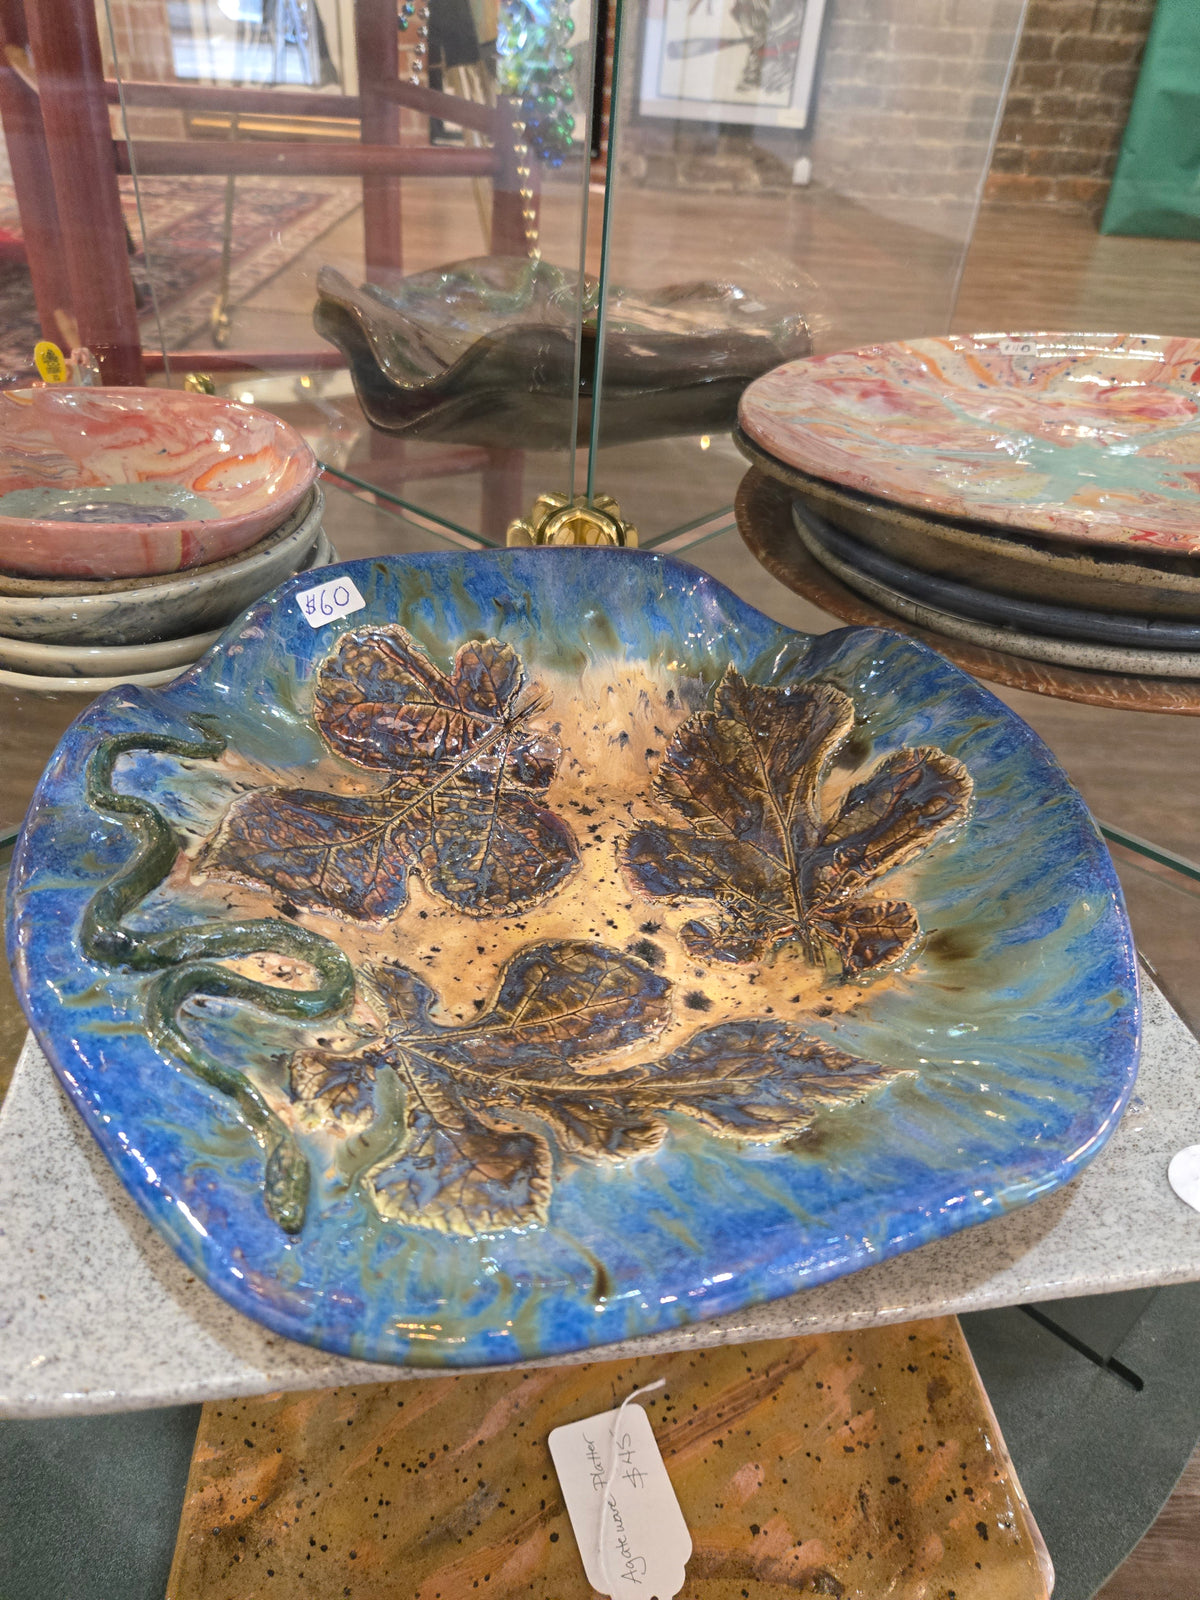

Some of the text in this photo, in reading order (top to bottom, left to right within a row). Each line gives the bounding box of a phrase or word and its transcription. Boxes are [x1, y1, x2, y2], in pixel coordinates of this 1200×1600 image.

[305, 585, 350, 616] $60
[582, 1432, 608, 1491] Platter
[608, 1428, 649, 1489] $45
